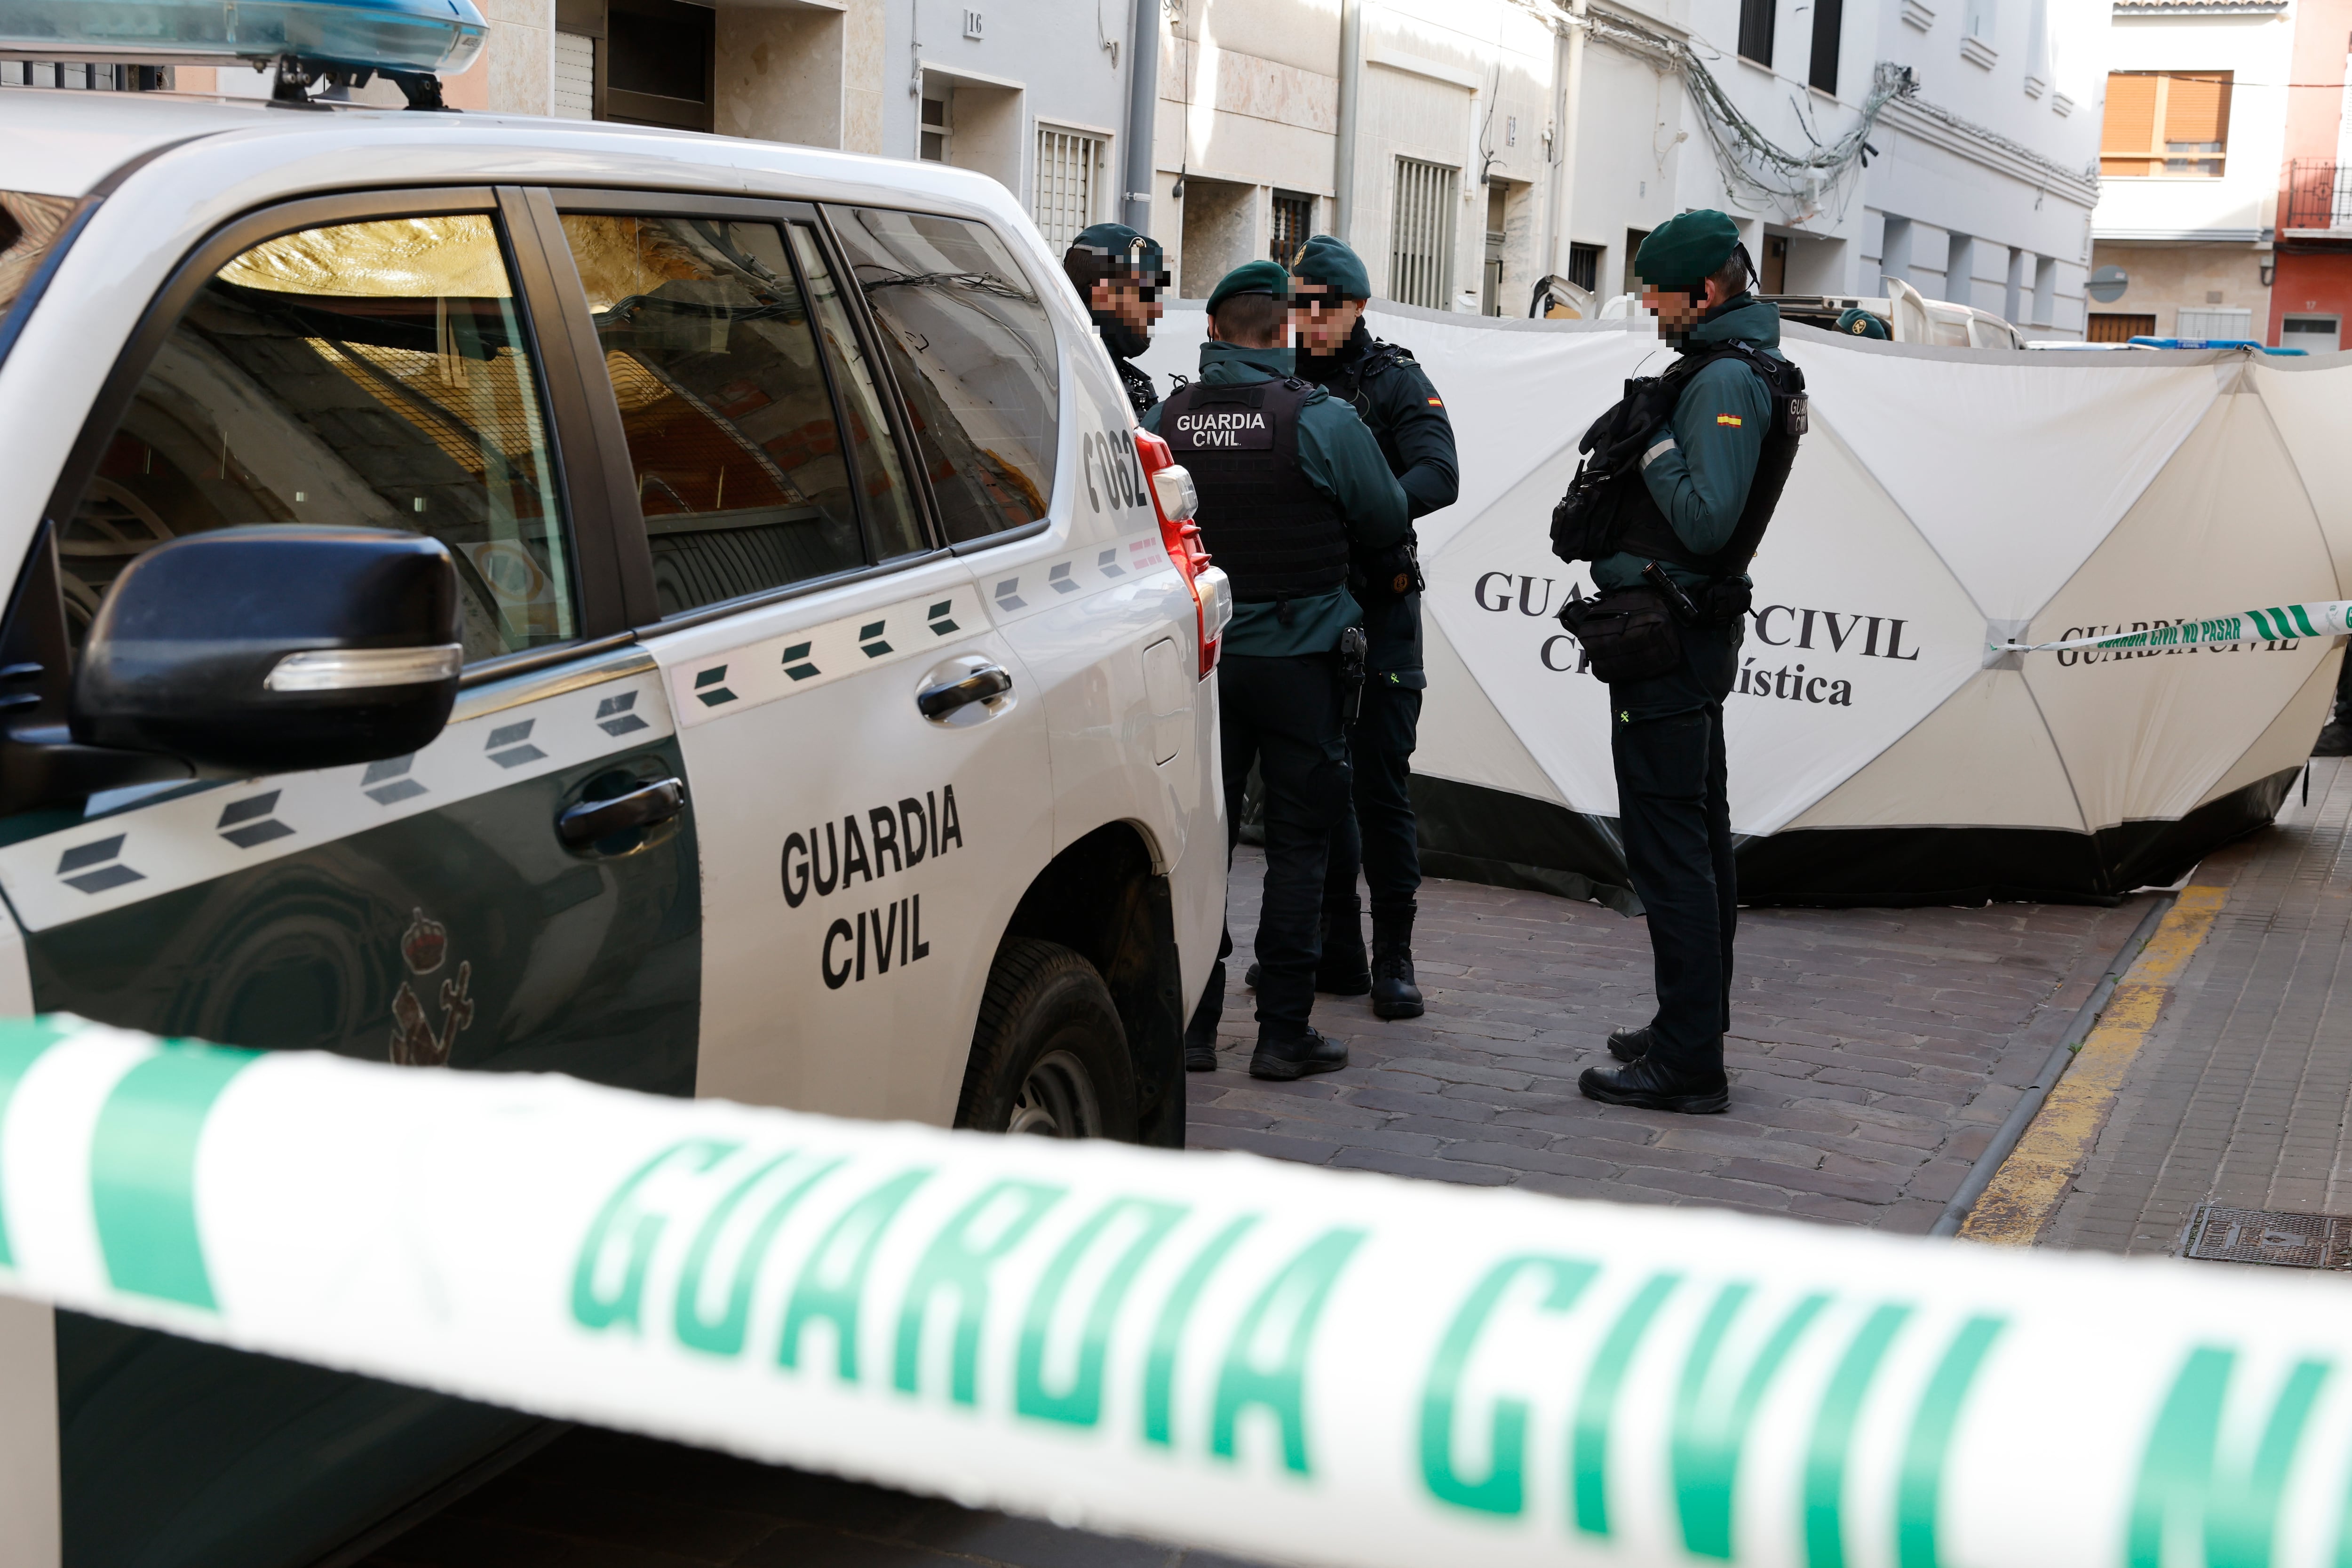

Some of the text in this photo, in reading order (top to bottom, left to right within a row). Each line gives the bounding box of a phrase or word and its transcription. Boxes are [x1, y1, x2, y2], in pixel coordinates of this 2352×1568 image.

[969, 13, 982, 33] 16
[2306, 300, 2317, 310] 17
[1177, 414, 1265, 431] GUARDIA
[1193, 430, 1242, 446] CIVIL
[1095, 430, 1147, 510] 062
[1755, 605, 1920, 661] CIVIL
[2150, 627, 2178, 646] CIVIL
[2182, 623, 2198, 644] NO
[2200, 618, 2241, 642] PASAR
[781, 784, 963, 908] GUARDIA
[822, 893, 930, 990] CIVIL
[571, 1135, 1371, 1478] GUARDIA
[1420, 1251, 2012, 1568] CIVIL
